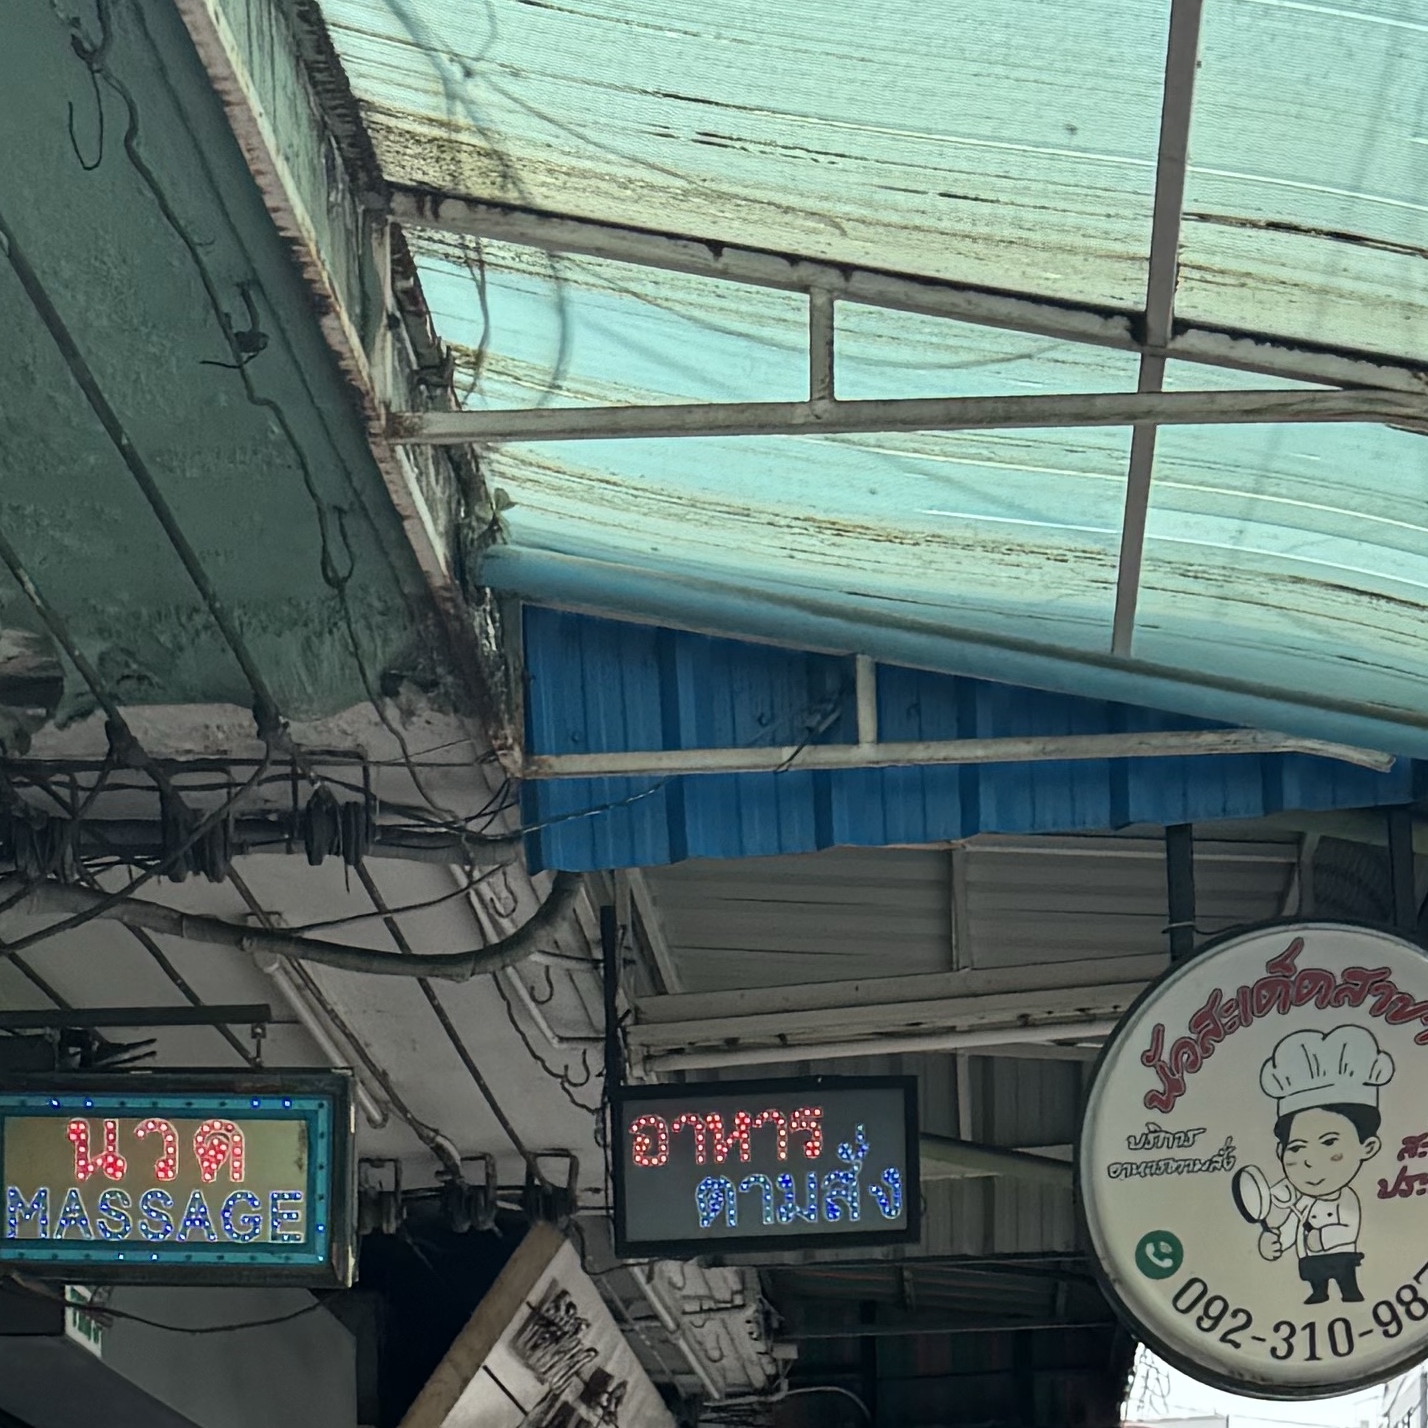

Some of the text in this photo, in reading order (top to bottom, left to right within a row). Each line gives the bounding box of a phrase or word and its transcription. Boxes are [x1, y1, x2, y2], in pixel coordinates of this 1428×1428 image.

[67, 1118, 245, 1182] นวด
[629, 1107, 822, 1166] อาหาร
[696, 1122, 902, 1227] ตามสั่ง
[7, 1187, 303, 1243] MASSAGE
